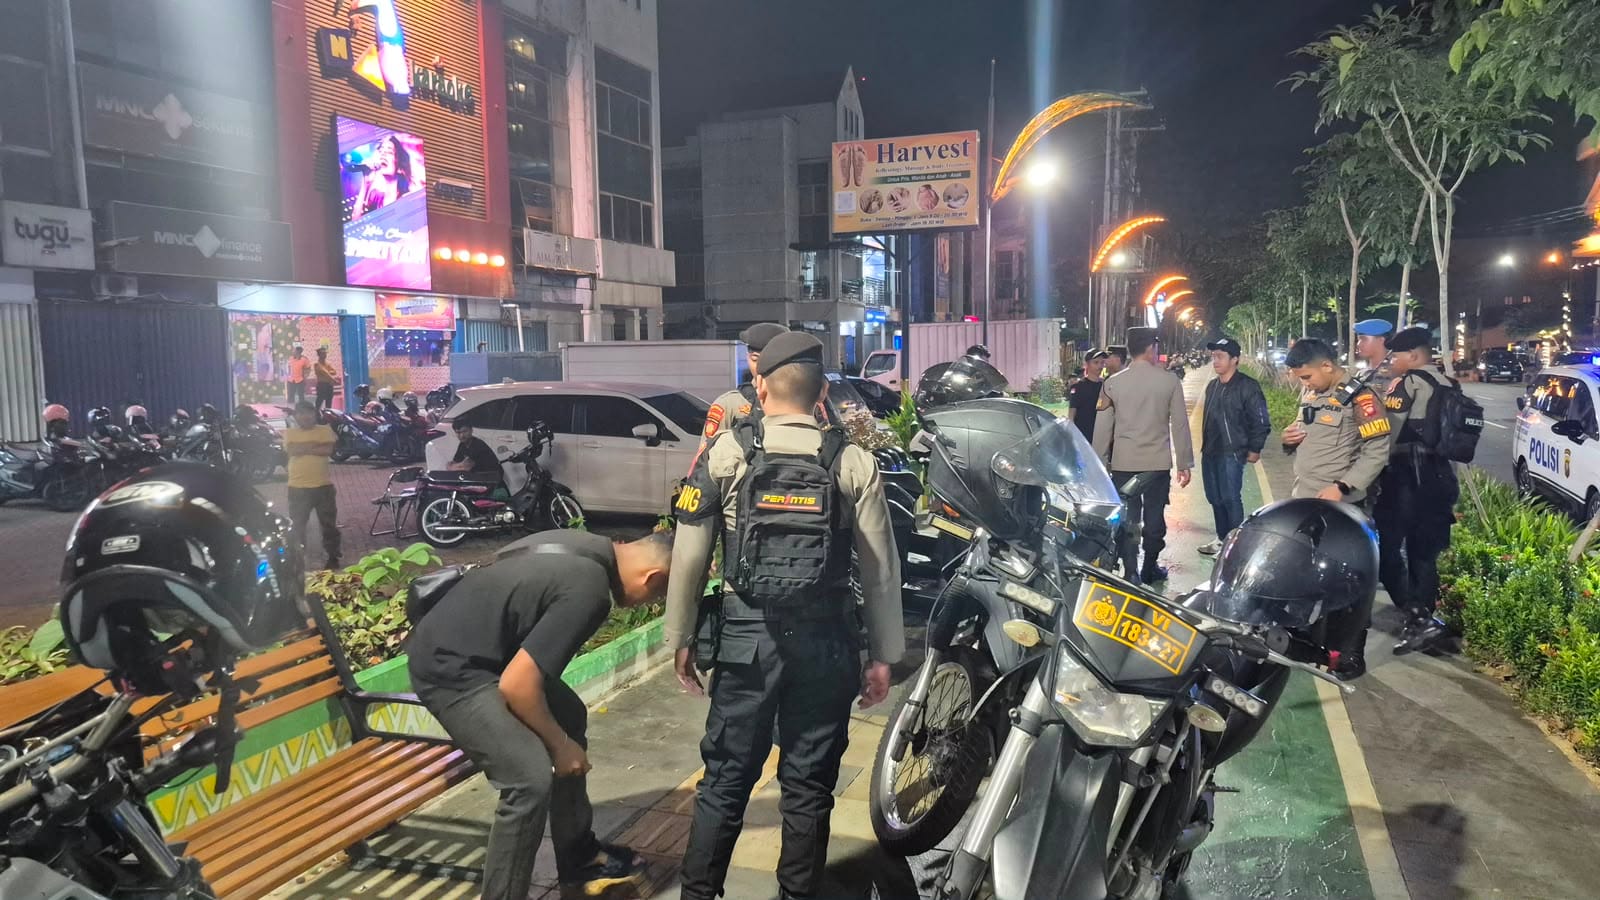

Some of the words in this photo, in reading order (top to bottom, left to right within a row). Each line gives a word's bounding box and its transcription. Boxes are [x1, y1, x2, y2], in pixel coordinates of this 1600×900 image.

[877, 139, 971, 164] Harvest
[14, 216, 69, 249] tugu
[153, 231, 195, 247] MNC
[1465, 418, 1483, 427] POLICE
[1529, 437, 1559, 474] POLISI
[1152, 609, 1172, 632] VI
